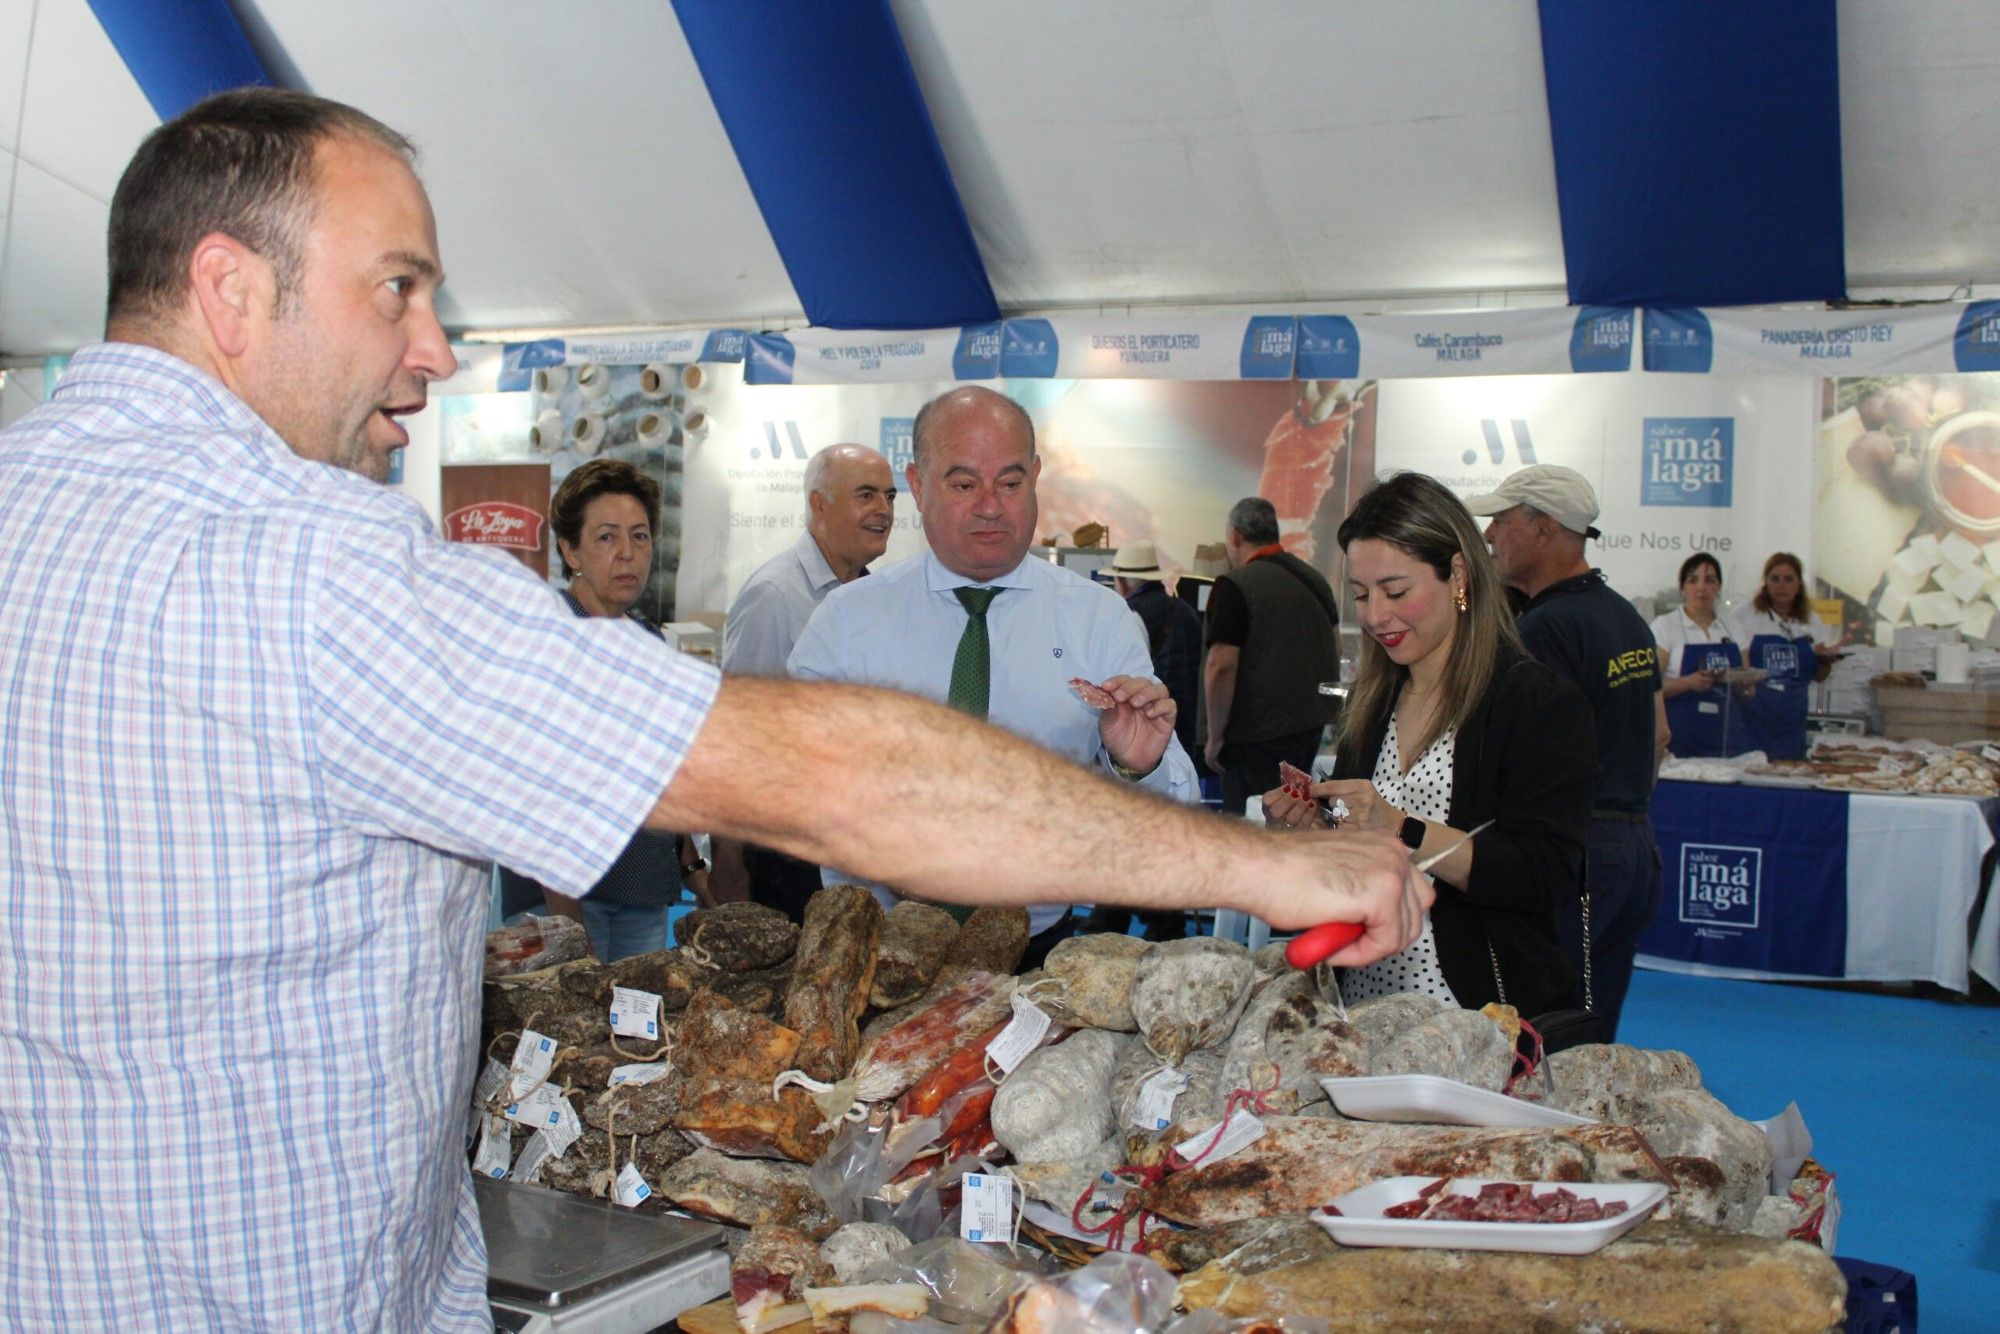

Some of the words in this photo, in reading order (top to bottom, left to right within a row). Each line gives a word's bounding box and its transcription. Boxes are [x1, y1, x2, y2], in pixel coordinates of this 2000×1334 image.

[1091, 334, 1127, 350] QUESOS
[1127, 334, 1139, 350] EL
[1826, 327, 1868, 344] CRISTO
[1870, 325, 1894, 342] REY
[1664, 427, 1723, 461] má
[1650, 452, 1723, 492] laga
[729, 511, 777, 528] Siente
[780, 512, 794, 528] el
[1594, 533, 1633, 552] que
[1640, 532, 1682, 551] Nos
[1689, 532, 1733, 551] Une
[1700, 856, 1750, 887] má
[1689, 874, 1750, 911] laga
